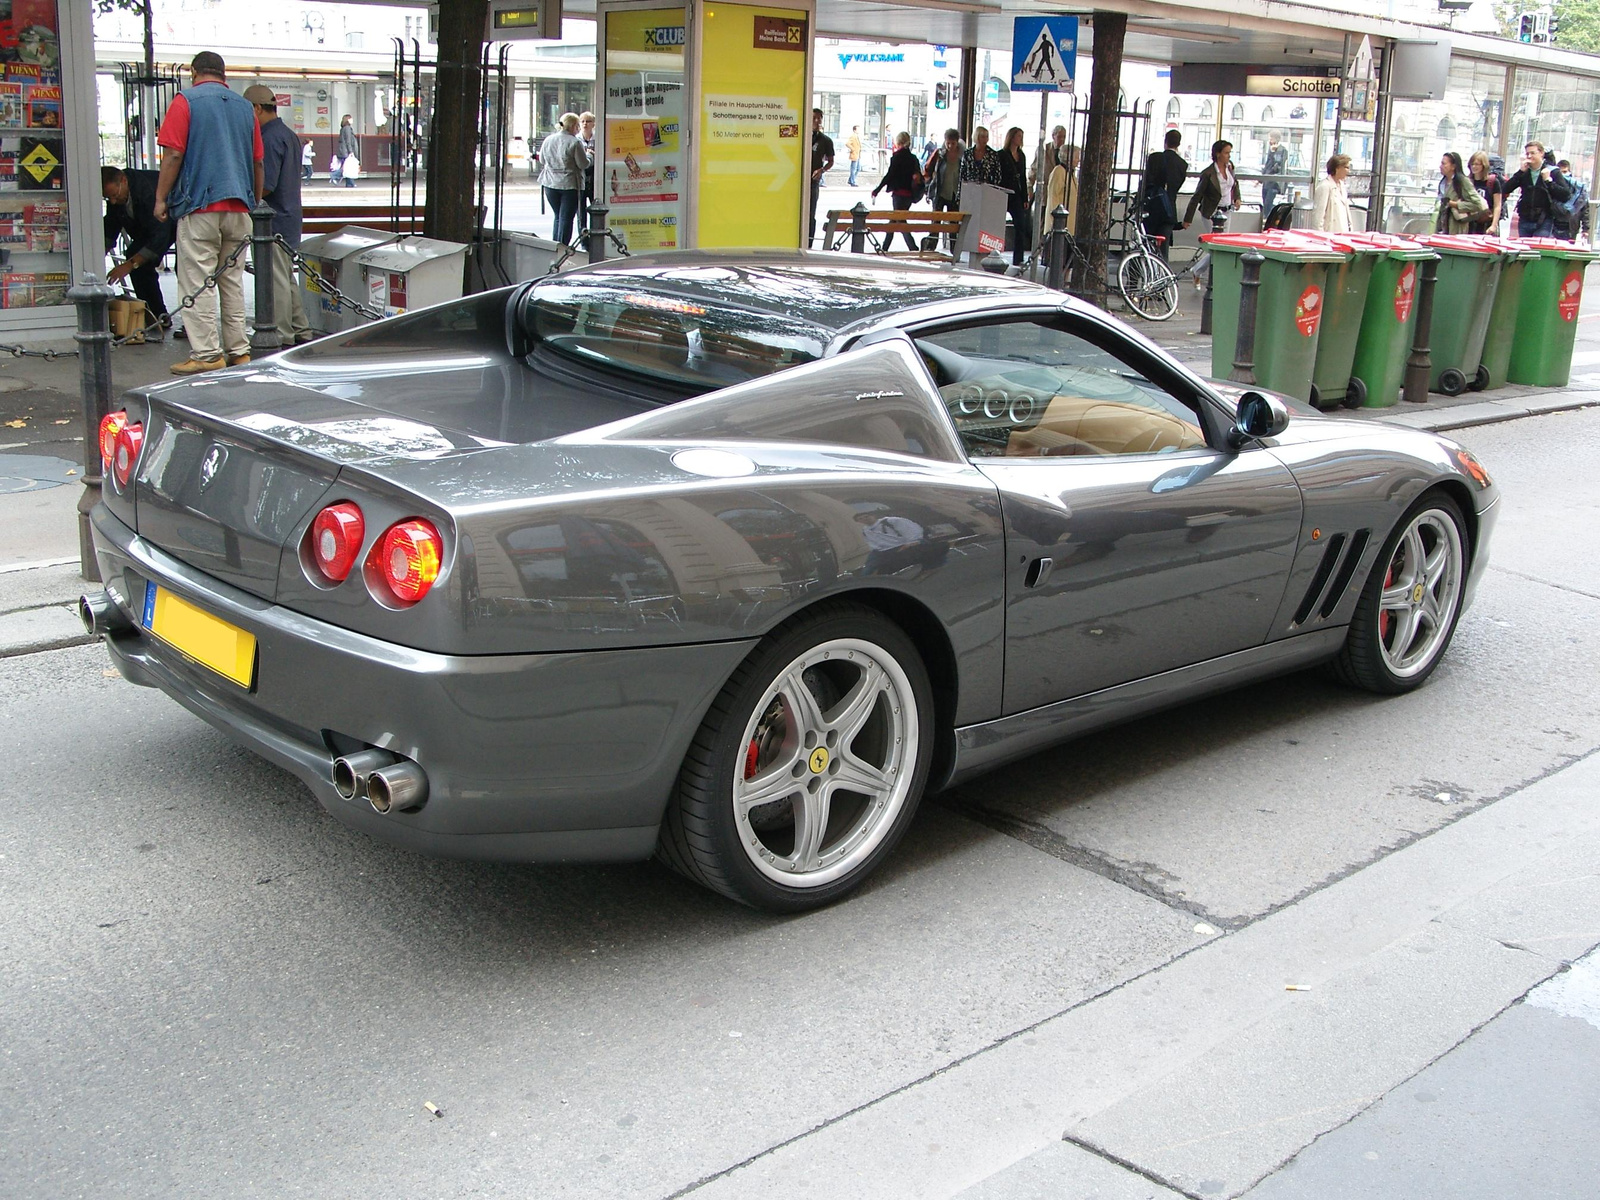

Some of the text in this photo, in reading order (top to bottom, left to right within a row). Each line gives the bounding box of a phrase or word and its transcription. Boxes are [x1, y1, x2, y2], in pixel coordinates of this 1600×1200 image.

[854, 53, 905, 62] VOLKSBANK
[10, 65, 38, 76] VIENNA
[32, 88, 60, 98] VIENNA
[620, 86, 632, 98] ganz
[712, 112, 757, 120] Schottengasse
[980, 233, 1003, 250] Heute
